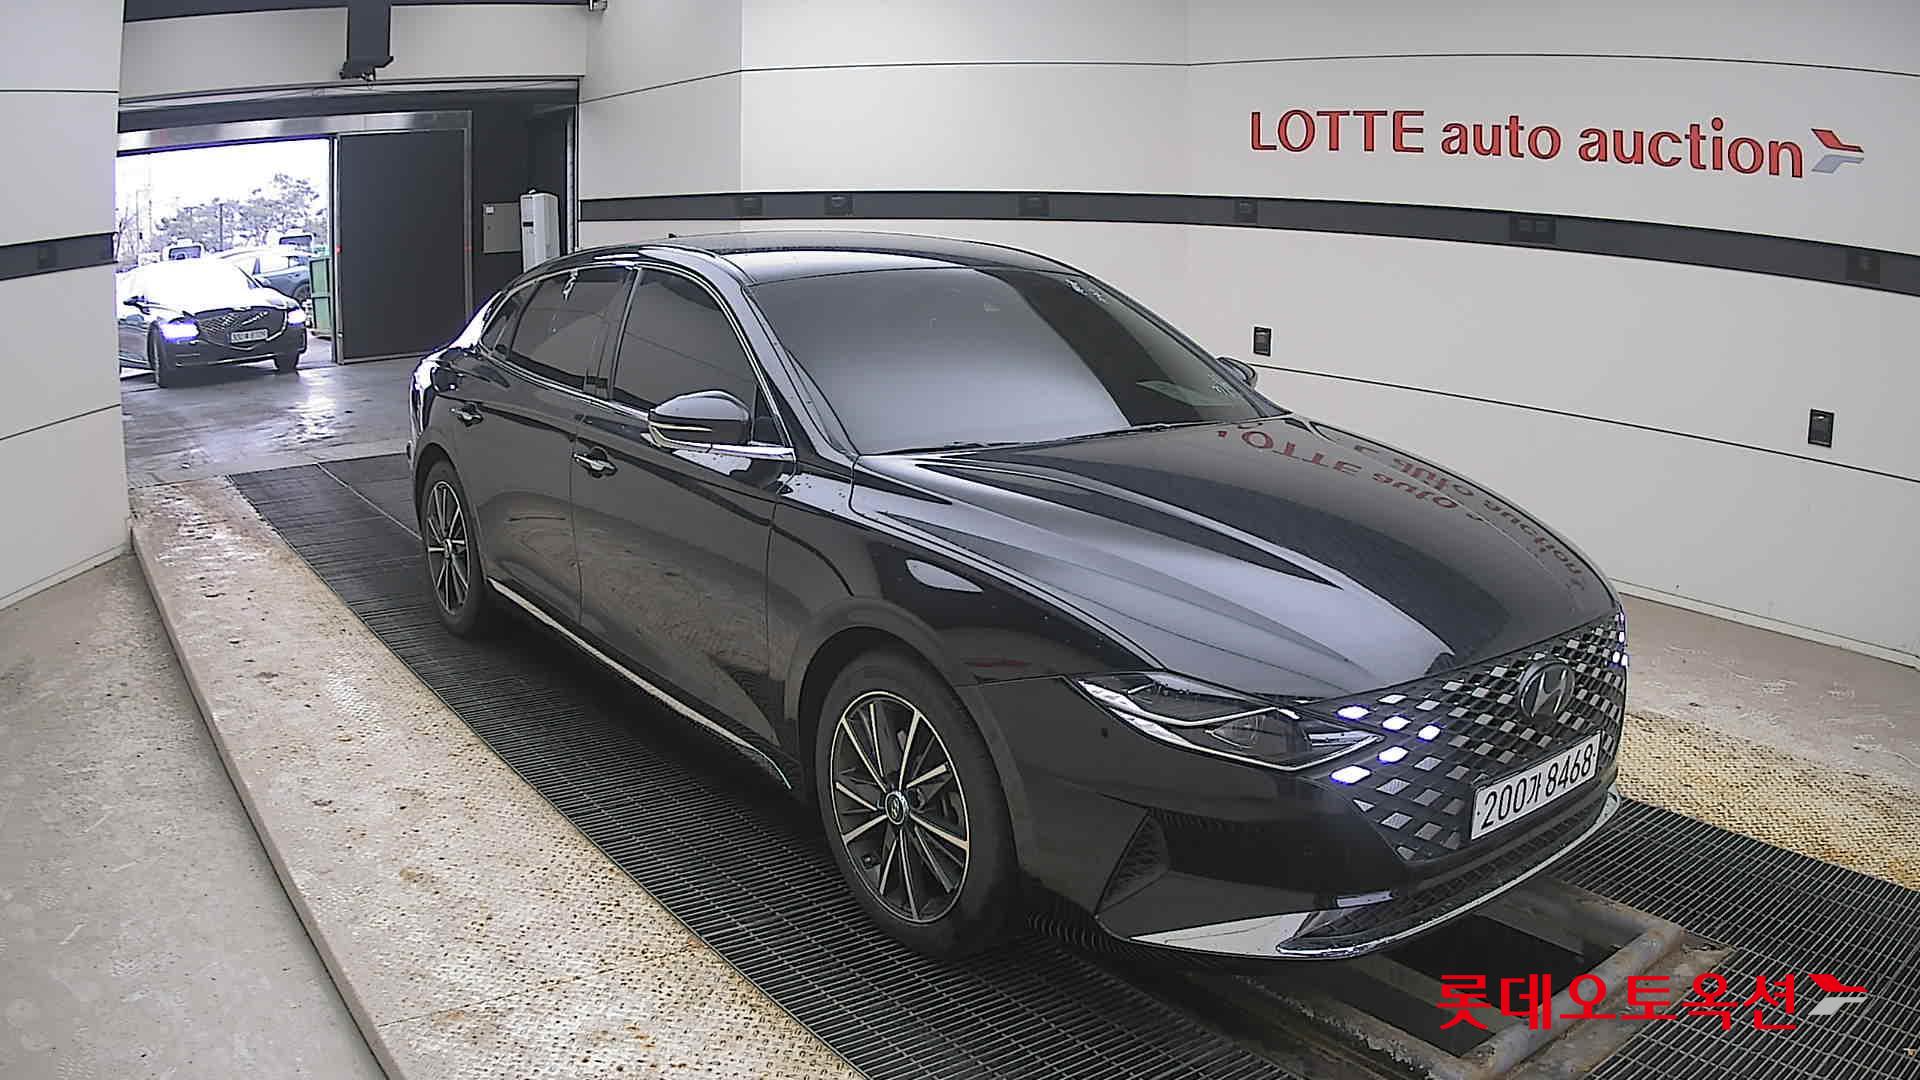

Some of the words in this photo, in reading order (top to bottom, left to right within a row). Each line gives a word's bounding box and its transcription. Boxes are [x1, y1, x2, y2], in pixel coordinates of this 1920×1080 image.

[1251, 110, 1424, 153] LOTTE
[1441, 116, 1562, 159] auto
[1577, 118, 1804, 178] auction
